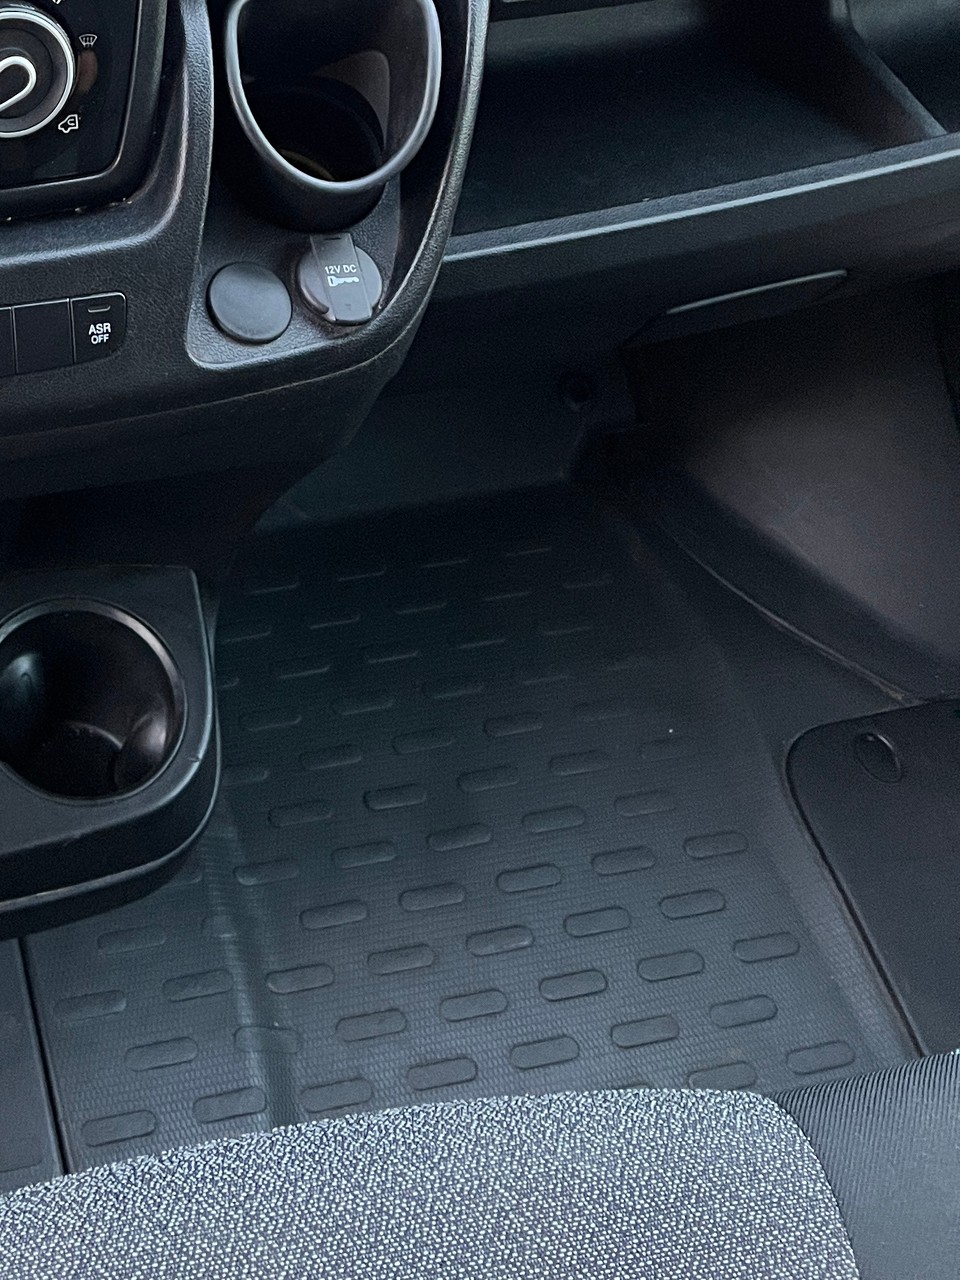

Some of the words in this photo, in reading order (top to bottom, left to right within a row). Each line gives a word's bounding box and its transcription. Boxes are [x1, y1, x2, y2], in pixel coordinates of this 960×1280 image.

[324, 264, 341, 275] 12V
[342, 264, 357, 273] DC
[88, 322, 112, 336] ASR
[90, 333, 110, 345] OFF
